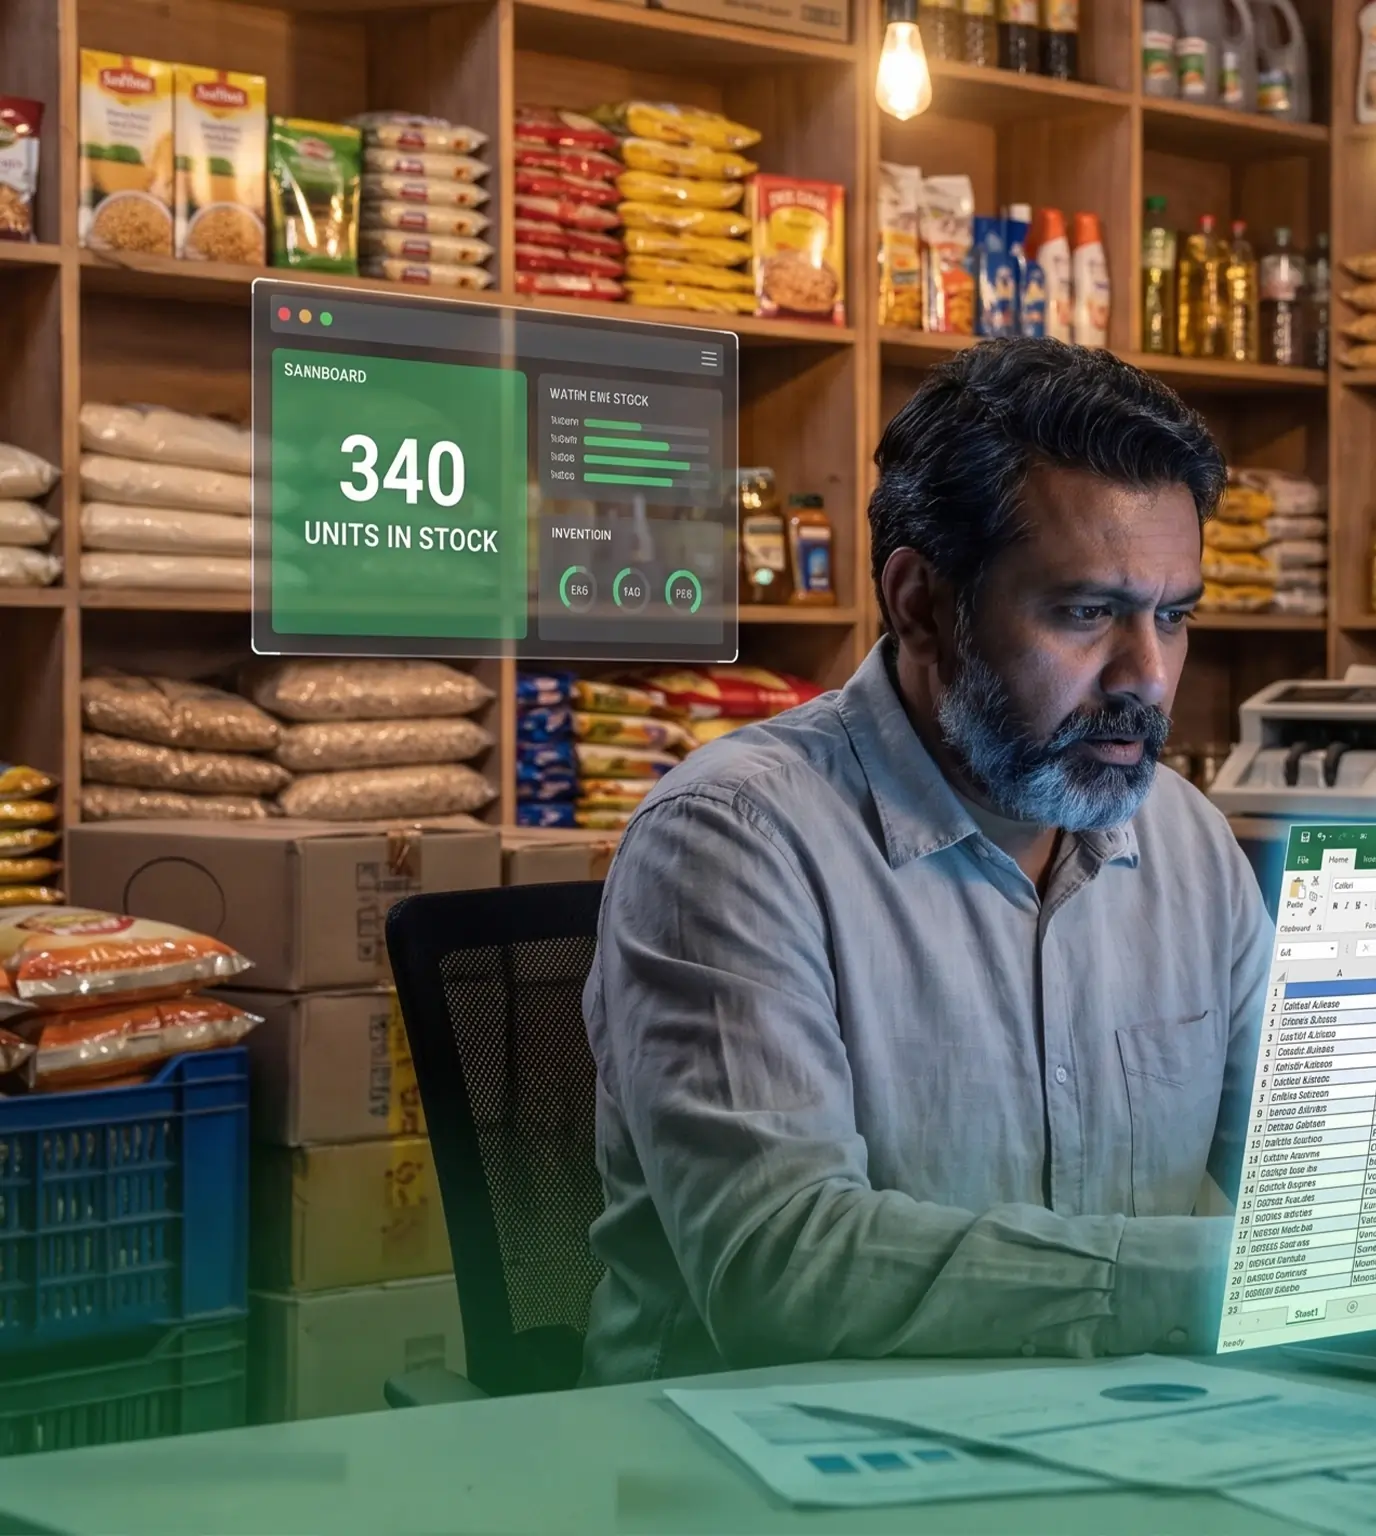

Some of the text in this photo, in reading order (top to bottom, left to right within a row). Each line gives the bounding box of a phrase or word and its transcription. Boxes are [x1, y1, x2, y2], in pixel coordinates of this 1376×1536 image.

[284, 362, 367, 383] SANNBOARD
[340, 434, 465, 507] 340
[305, 520, 498, 552] UNITS IN STOCK
[1337, 969, 1343, 977] A
[1274, 988, 1278, 997] 1
[1271, 1003, 1277, 1012] 2
[1267, 1033, 1273, 1042] 3
[1261, 1079, 1267, 1088] 6
[1238, 1230, 1248, 1239] 17
[1229, 1291, 1240, 1300] 23
